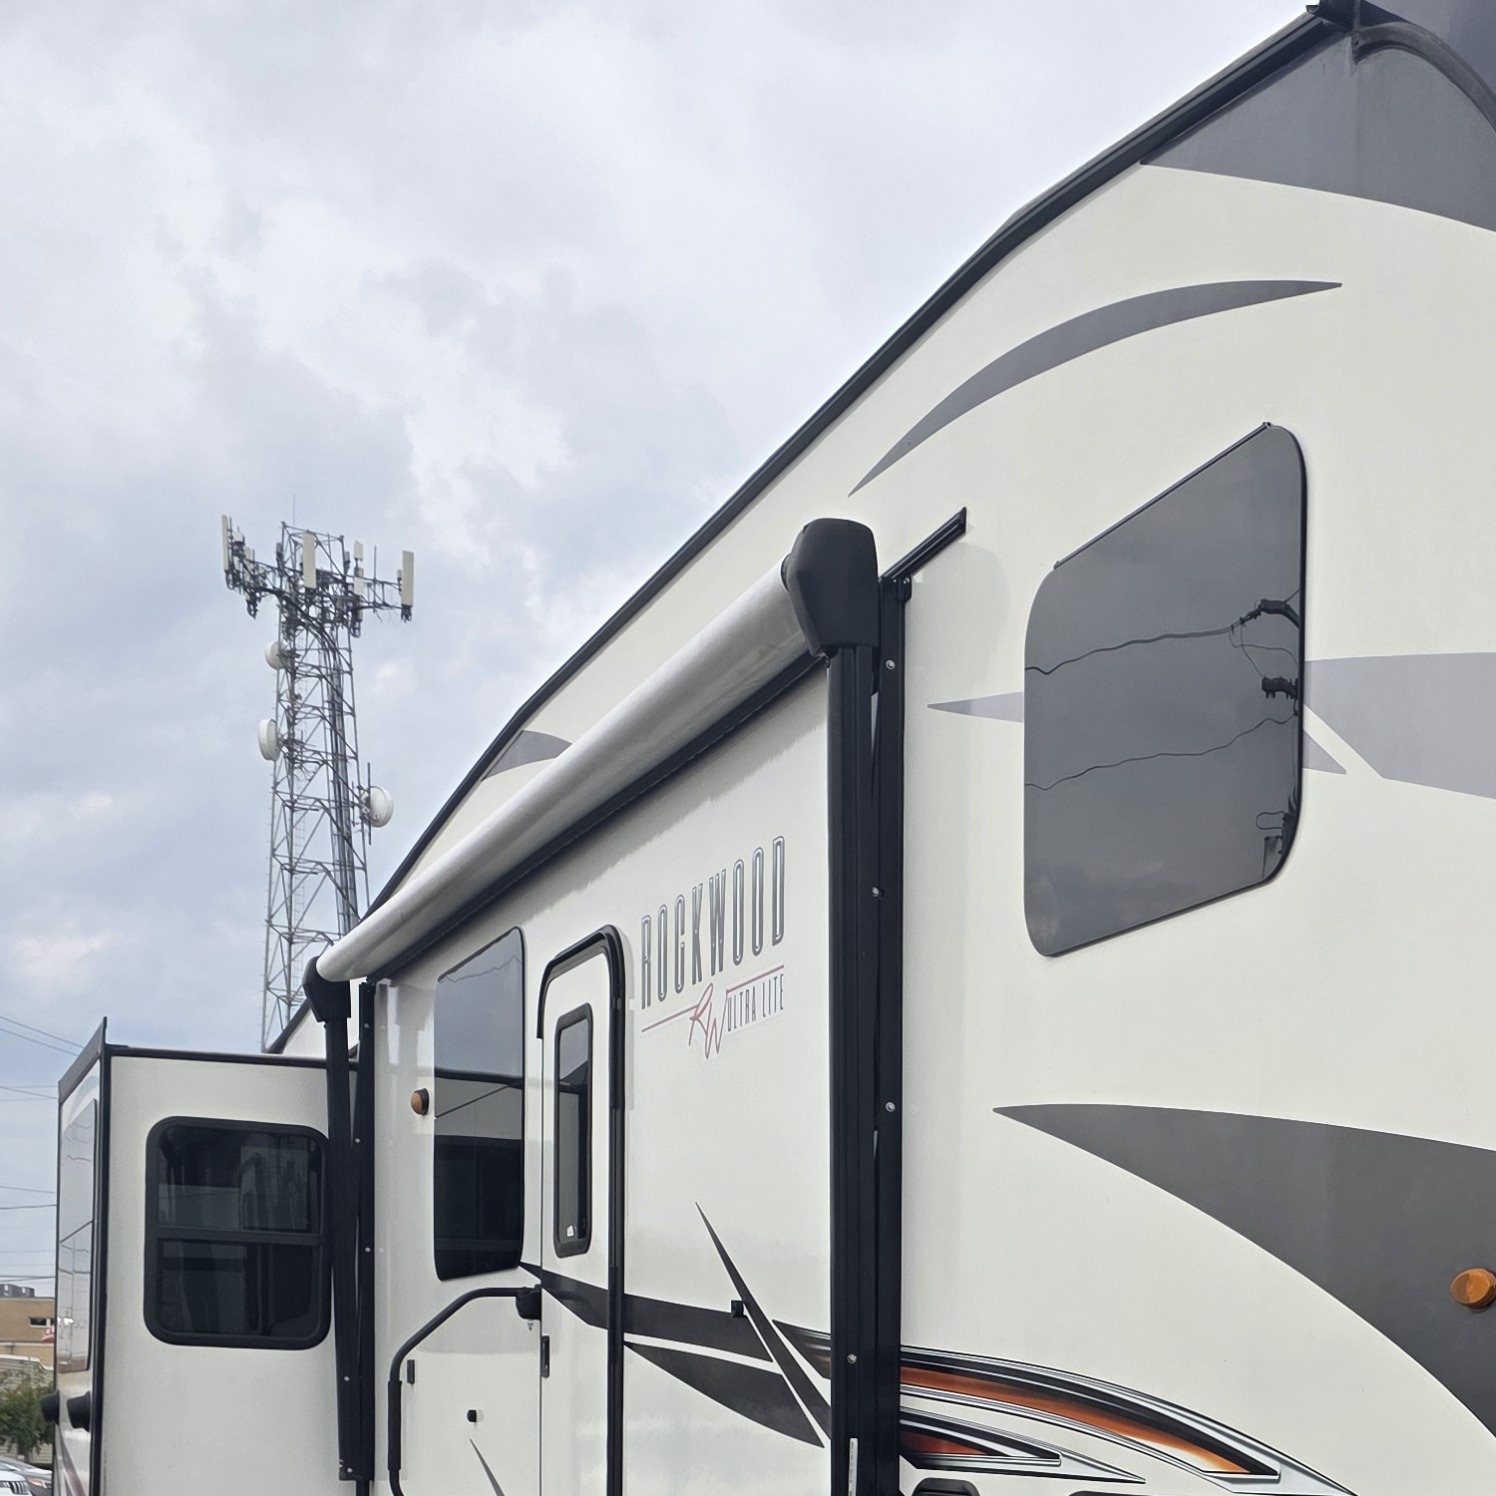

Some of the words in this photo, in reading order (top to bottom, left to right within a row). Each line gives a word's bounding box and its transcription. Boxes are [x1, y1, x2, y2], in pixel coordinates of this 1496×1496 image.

[640, 835, 785, 1010] ROCKWOOD
[727, 986, 757, 1033] ULTRA
[761, 973, 785, 1018] LITE
